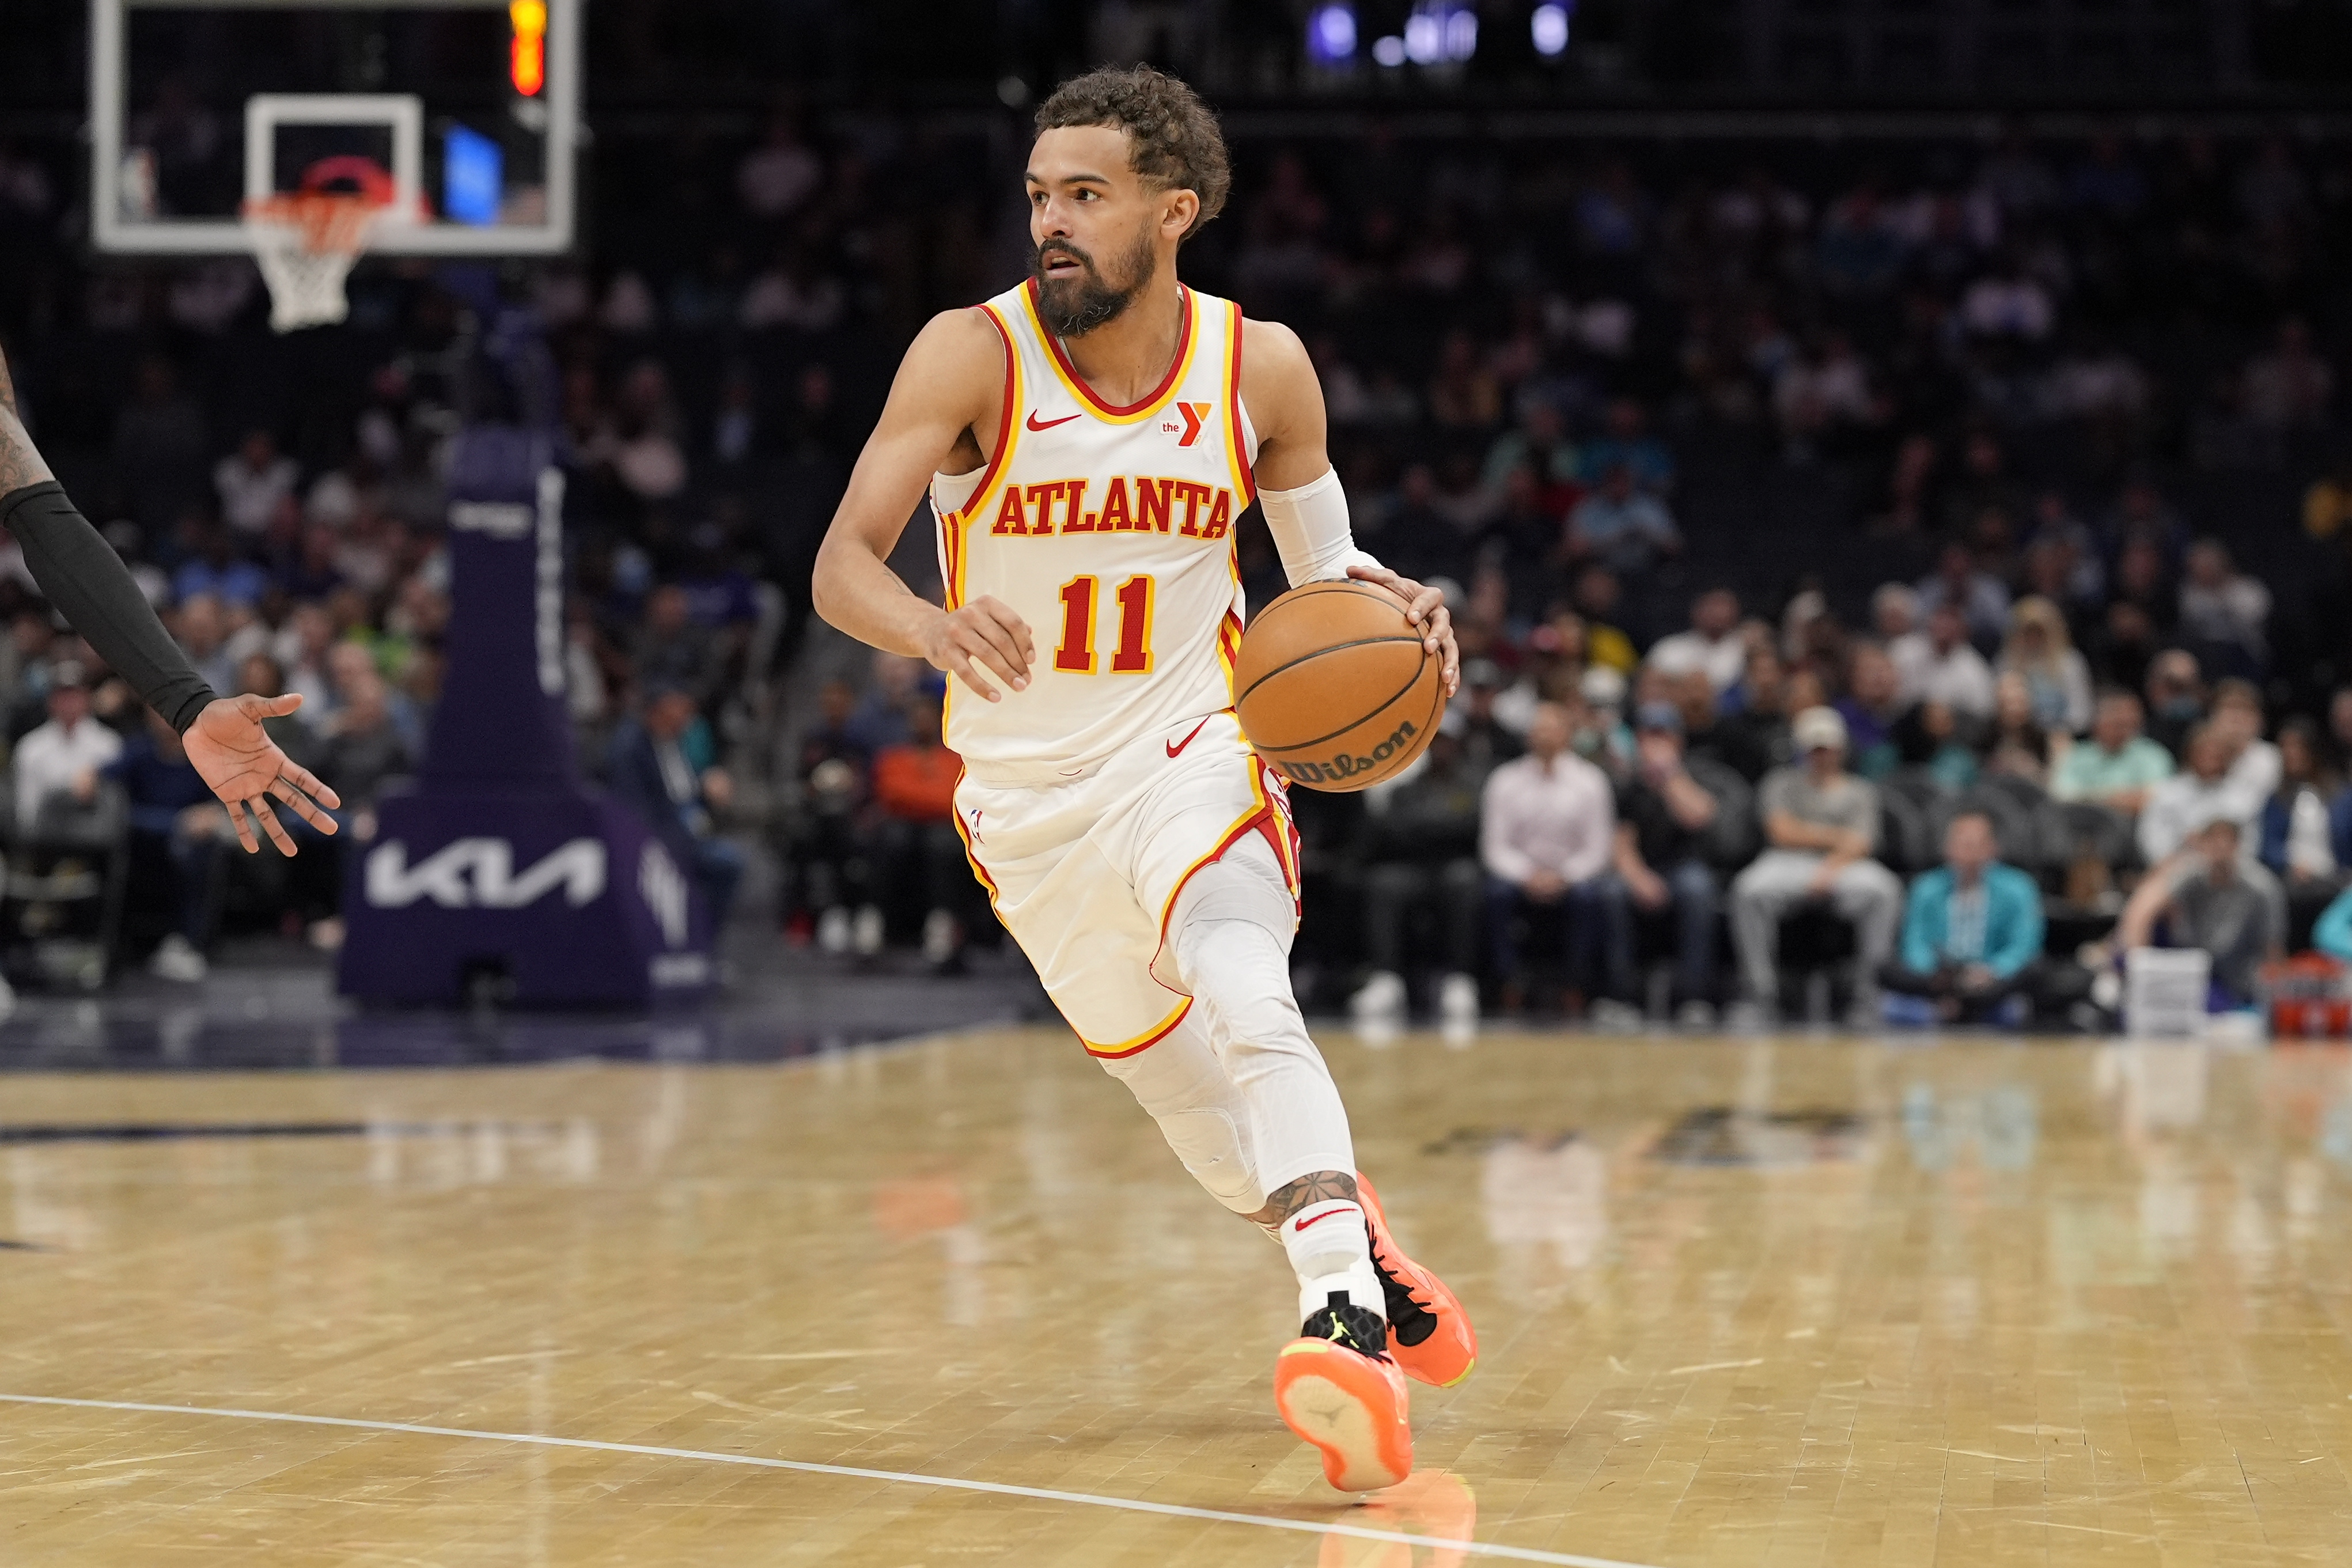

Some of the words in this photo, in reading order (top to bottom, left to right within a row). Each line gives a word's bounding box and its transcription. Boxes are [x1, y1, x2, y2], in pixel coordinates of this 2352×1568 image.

[1162, 422, 1179, 432] the
[990, 476, 1232, 540] ATLANTA
[1053, 574, 1155, 675] 11
[1278, 721, 1418, 783] Wilson
